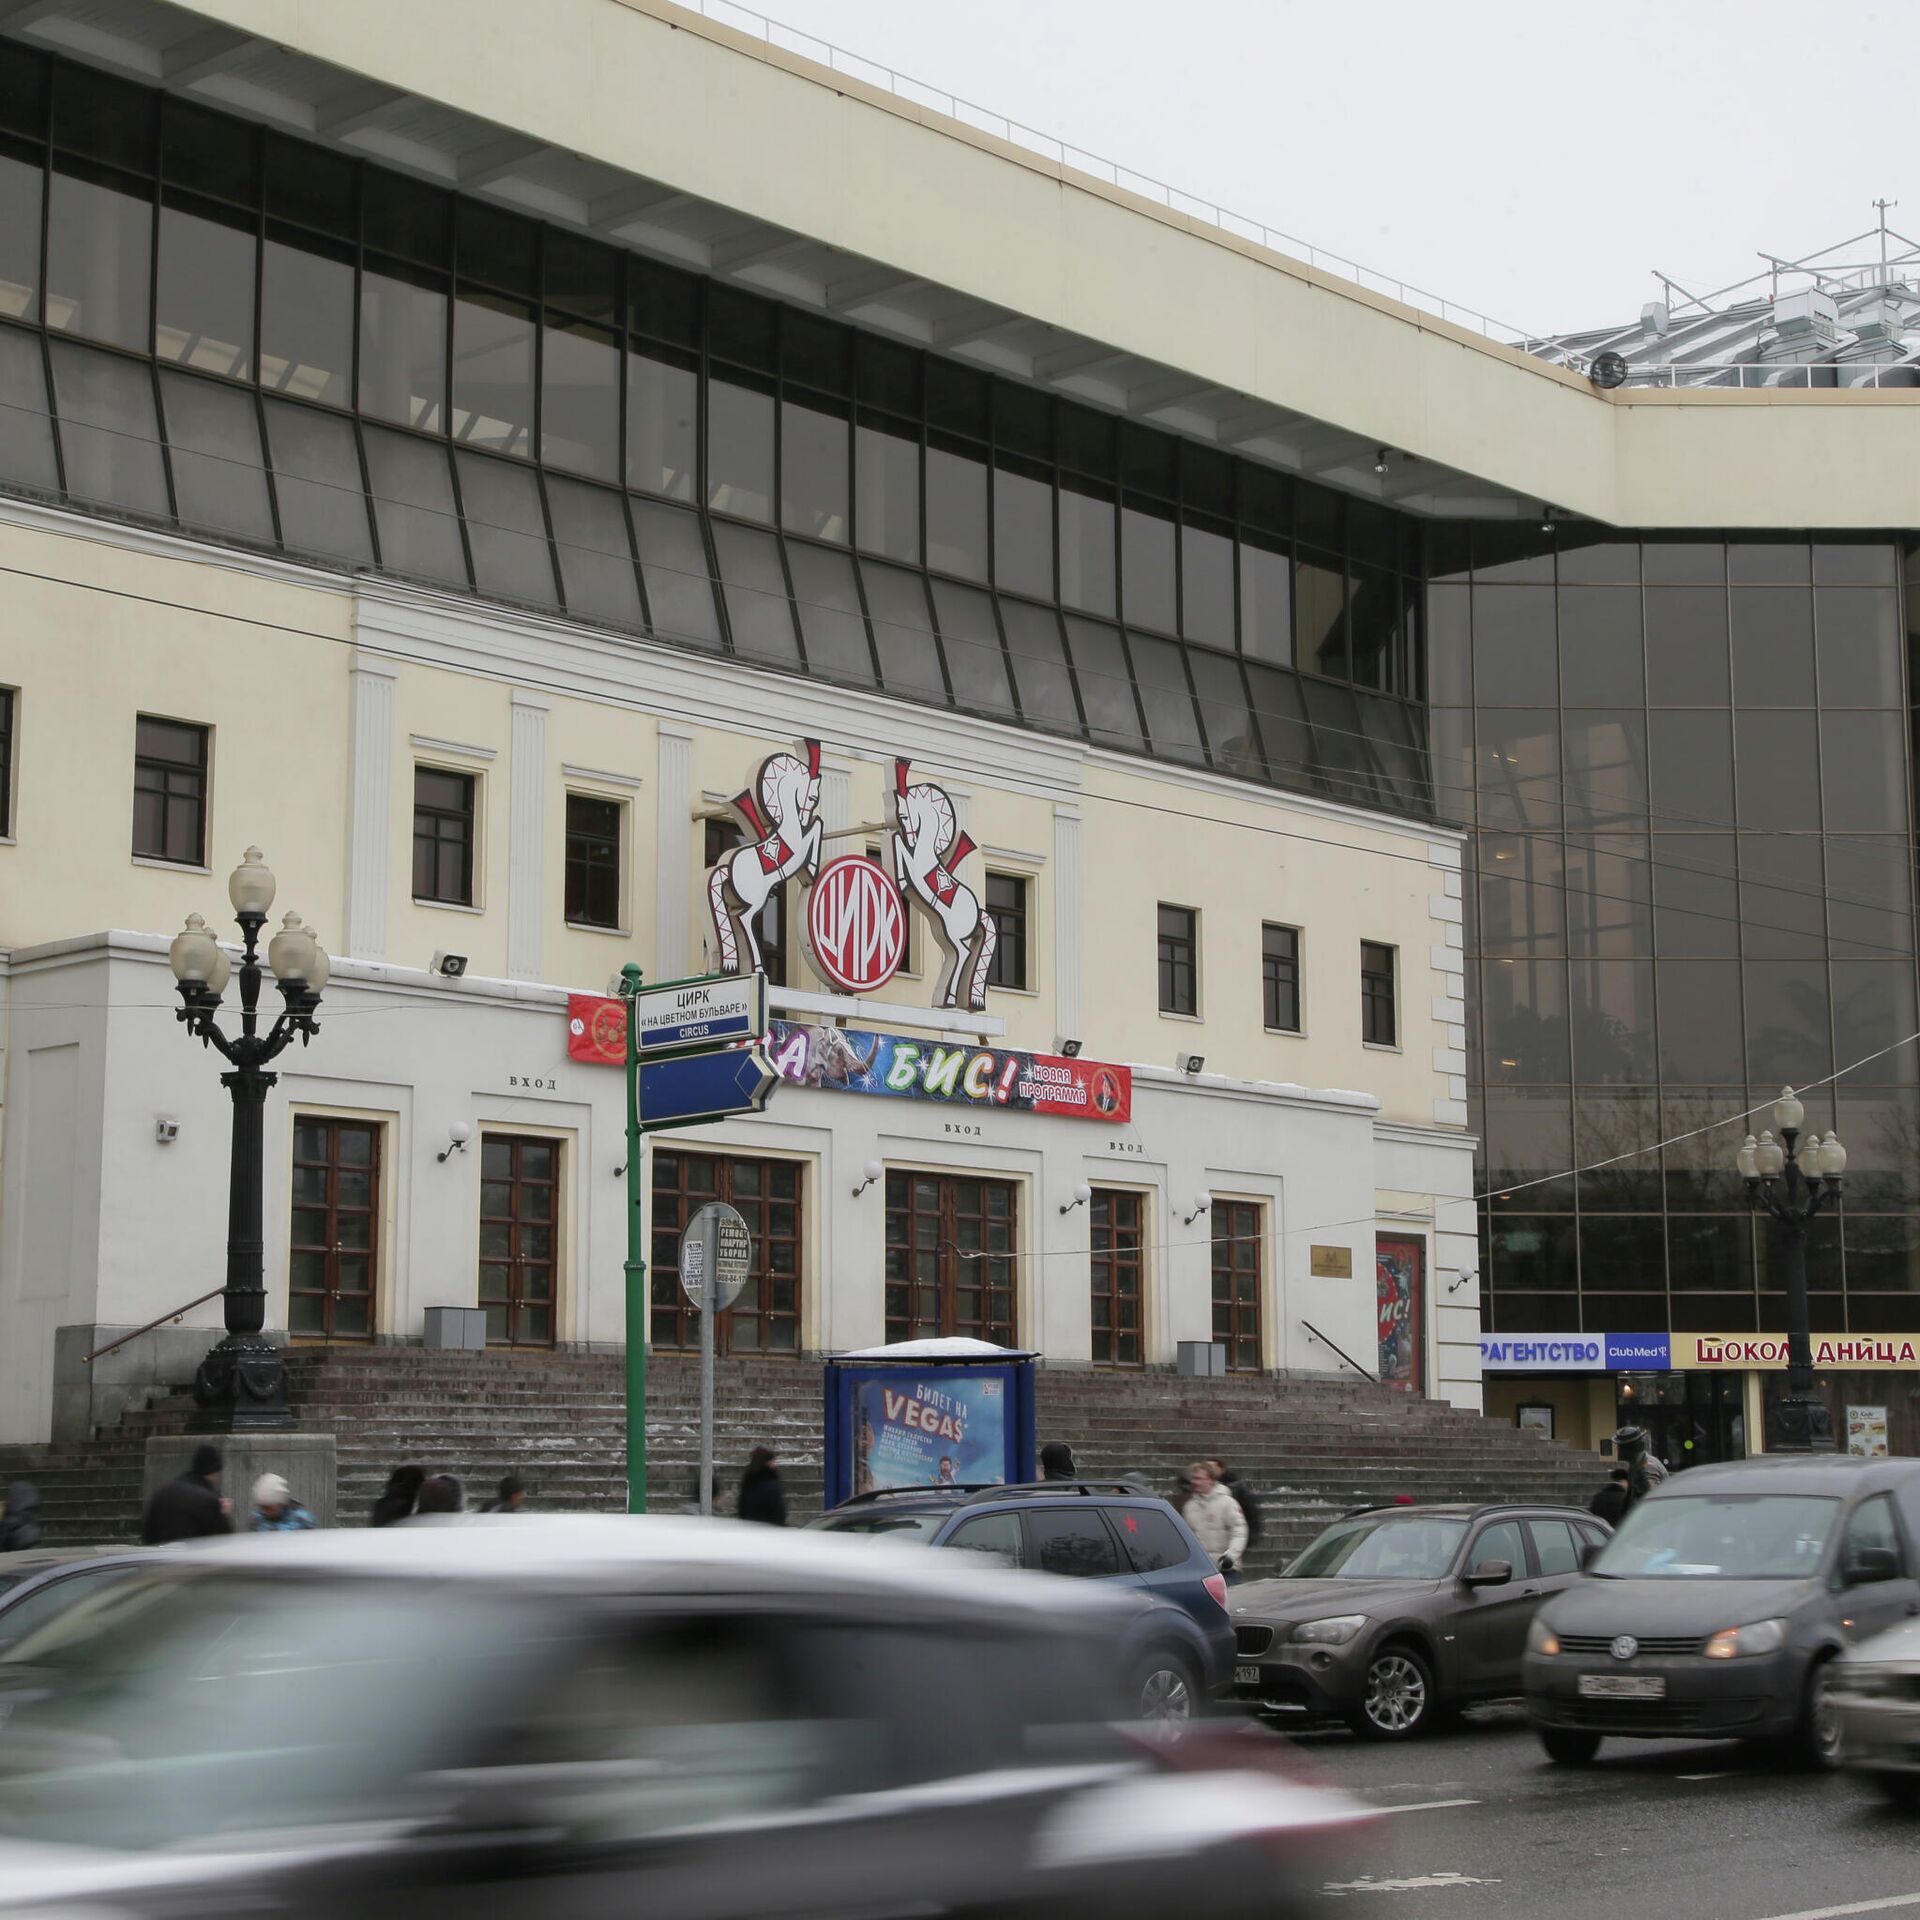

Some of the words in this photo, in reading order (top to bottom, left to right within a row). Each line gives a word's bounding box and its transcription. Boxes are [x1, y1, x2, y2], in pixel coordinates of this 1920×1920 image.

[819, 867, 897, 981] ЦИРК
[677, 989, 711, 1009] ЦИРК
[660, 1009, 698, 1026] ЦВЕТНОМ
[699, 1003, 748, 1019] БУЛЬВАРЕ»
[679, 1024, 710, 1039] CIRCUS
[509, 1075, 556, 1091] ВХОД
[885, 1044, 1018, 1103] БИС!
[1033, 1065, 1072, 1085] НОВАЯ
[1019, 1081, 1087, 1105] ПРОГРАММА
[944, 1123, 982, 1136] ВХОД
[1109, 1141, 1144, 1154] ВХОД
[1608, 1346, 1633, 1357] Club
[1634, 1347, 1657, 1357] Med
[1697, 1338, 1916, 1363] ШОКОЛДНИЦА
[916, 1384, 952, 1411] БИЛЕТ
[956, 1400, 967, 1419] НА
